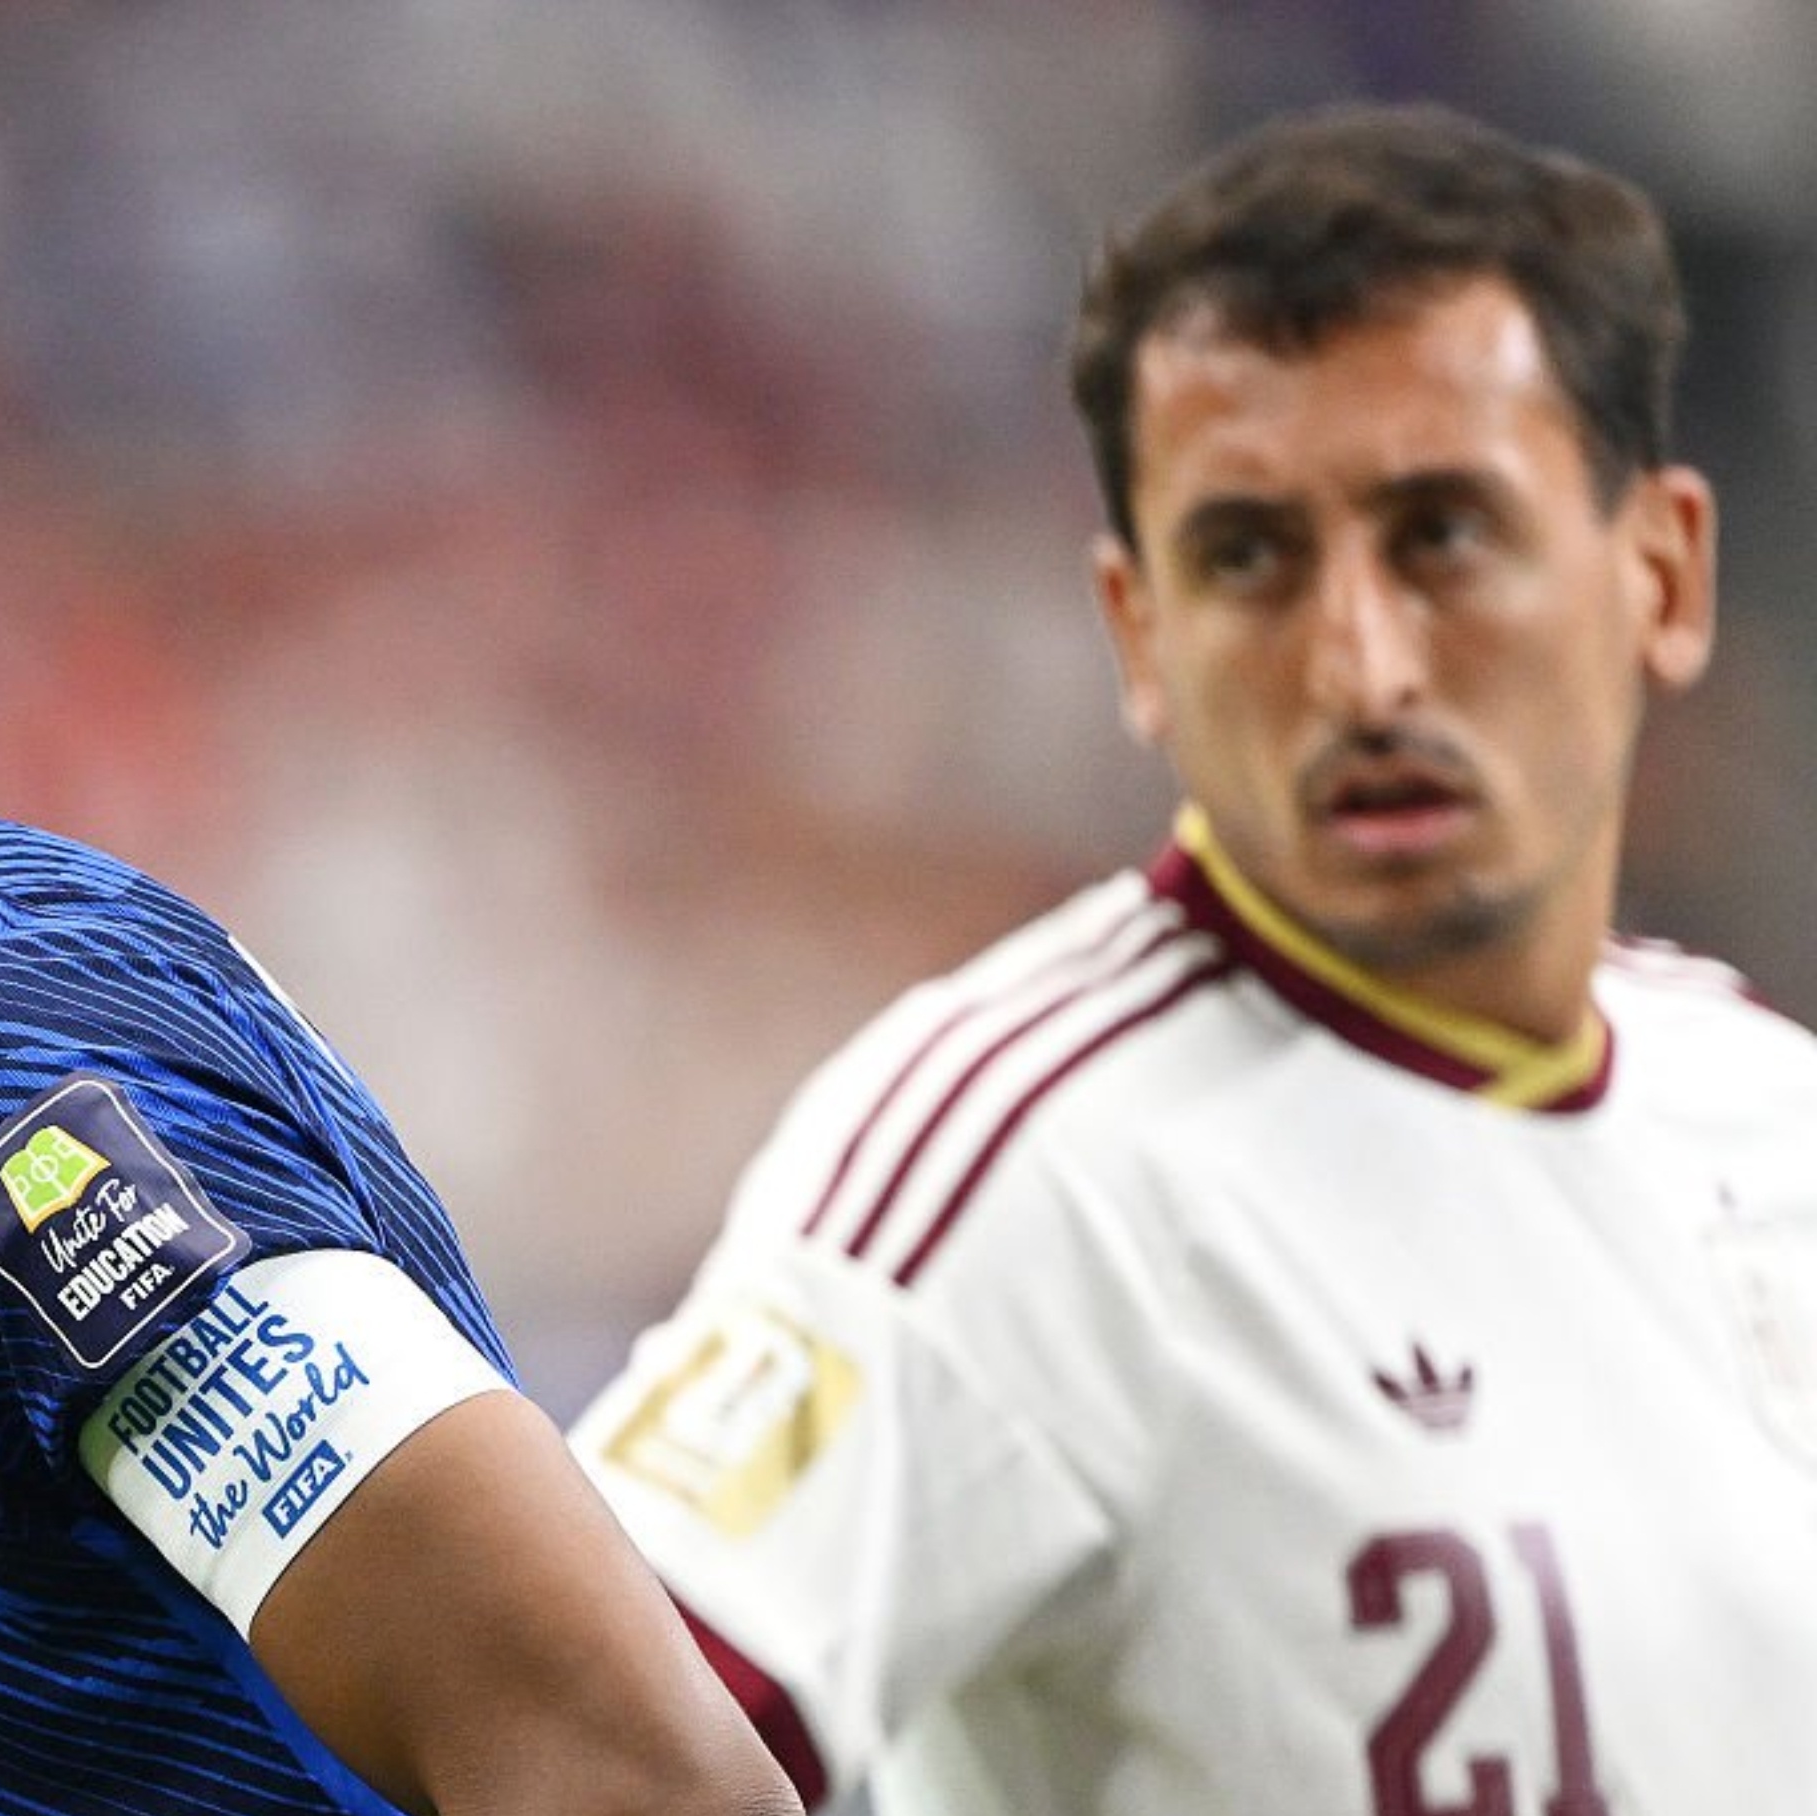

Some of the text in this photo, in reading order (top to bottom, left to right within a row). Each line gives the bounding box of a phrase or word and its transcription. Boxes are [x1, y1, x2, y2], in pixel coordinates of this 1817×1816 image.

[40, 1177, 138, 1274] Unite For
[56, 1202, 190, 1322] EDUCATION
[119, 1263, 174, 1311] FIFA
[107, 1284, 269, 1456] FOOTBALL
[141, 1313, 315, 1501] UNITES
[189, 1340, 371, 1550] the World
[271, 1456, 339, 1527] FIFA
